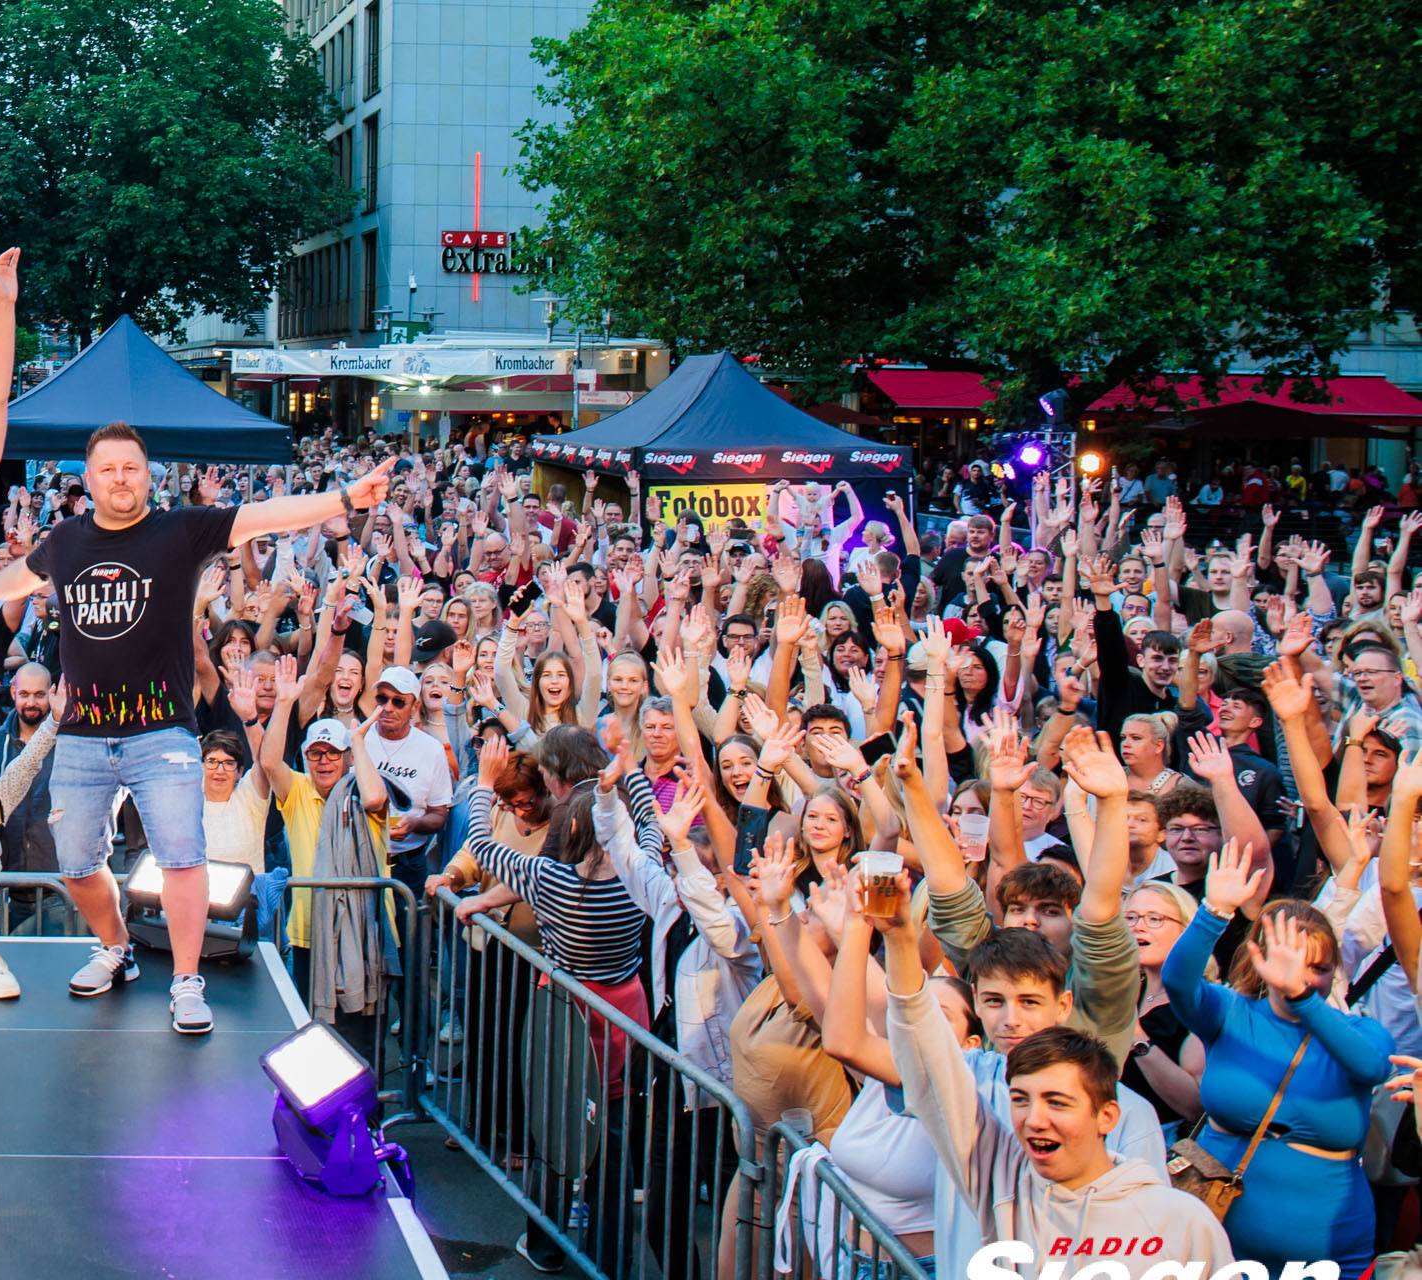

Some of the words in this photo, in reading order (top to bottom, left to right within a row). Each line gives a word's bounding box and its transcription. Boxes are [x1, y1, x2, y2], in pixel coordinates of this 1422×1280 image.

[444, 233, 505, 245] CAFE
[330, 355, 392, 370] Krombacher
[495, 355, 554, 370] Krombacher
[645, 452, 693, 465] Siegen
[712, 452, 762, 465] Siegen
[781, 451, 830, 464] Siegen
[849, 450, 899, 463] Siegen
[655, 489, 761, 519] Fotobox
[64, 578, 152, 604] KULTHIT
[77, 600, 136, 626] PARTY
